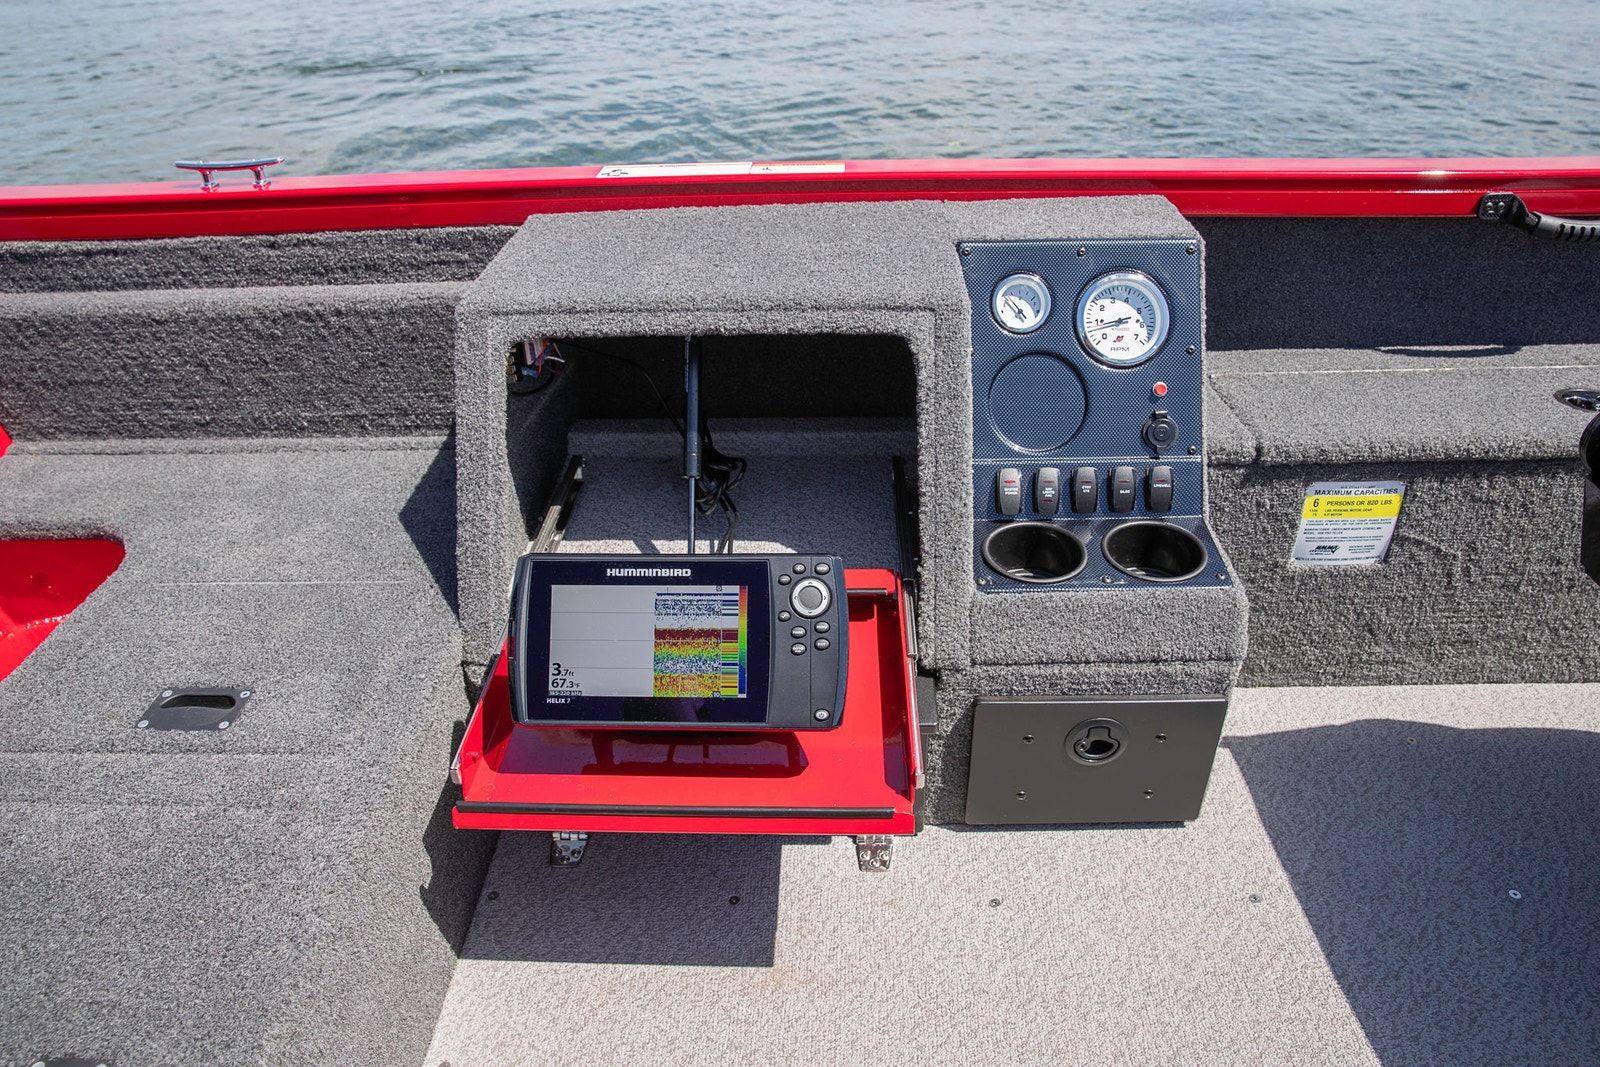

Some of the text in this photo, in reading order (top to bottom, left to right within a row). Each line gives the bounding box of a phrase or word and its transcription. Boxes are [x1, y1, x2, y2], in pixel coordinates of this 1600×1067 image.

[1134, 333, 1139, 341] 7
[1313, 497, 1320, 508] 6
[606, 568, 692, 577] HUMMINBIRD
